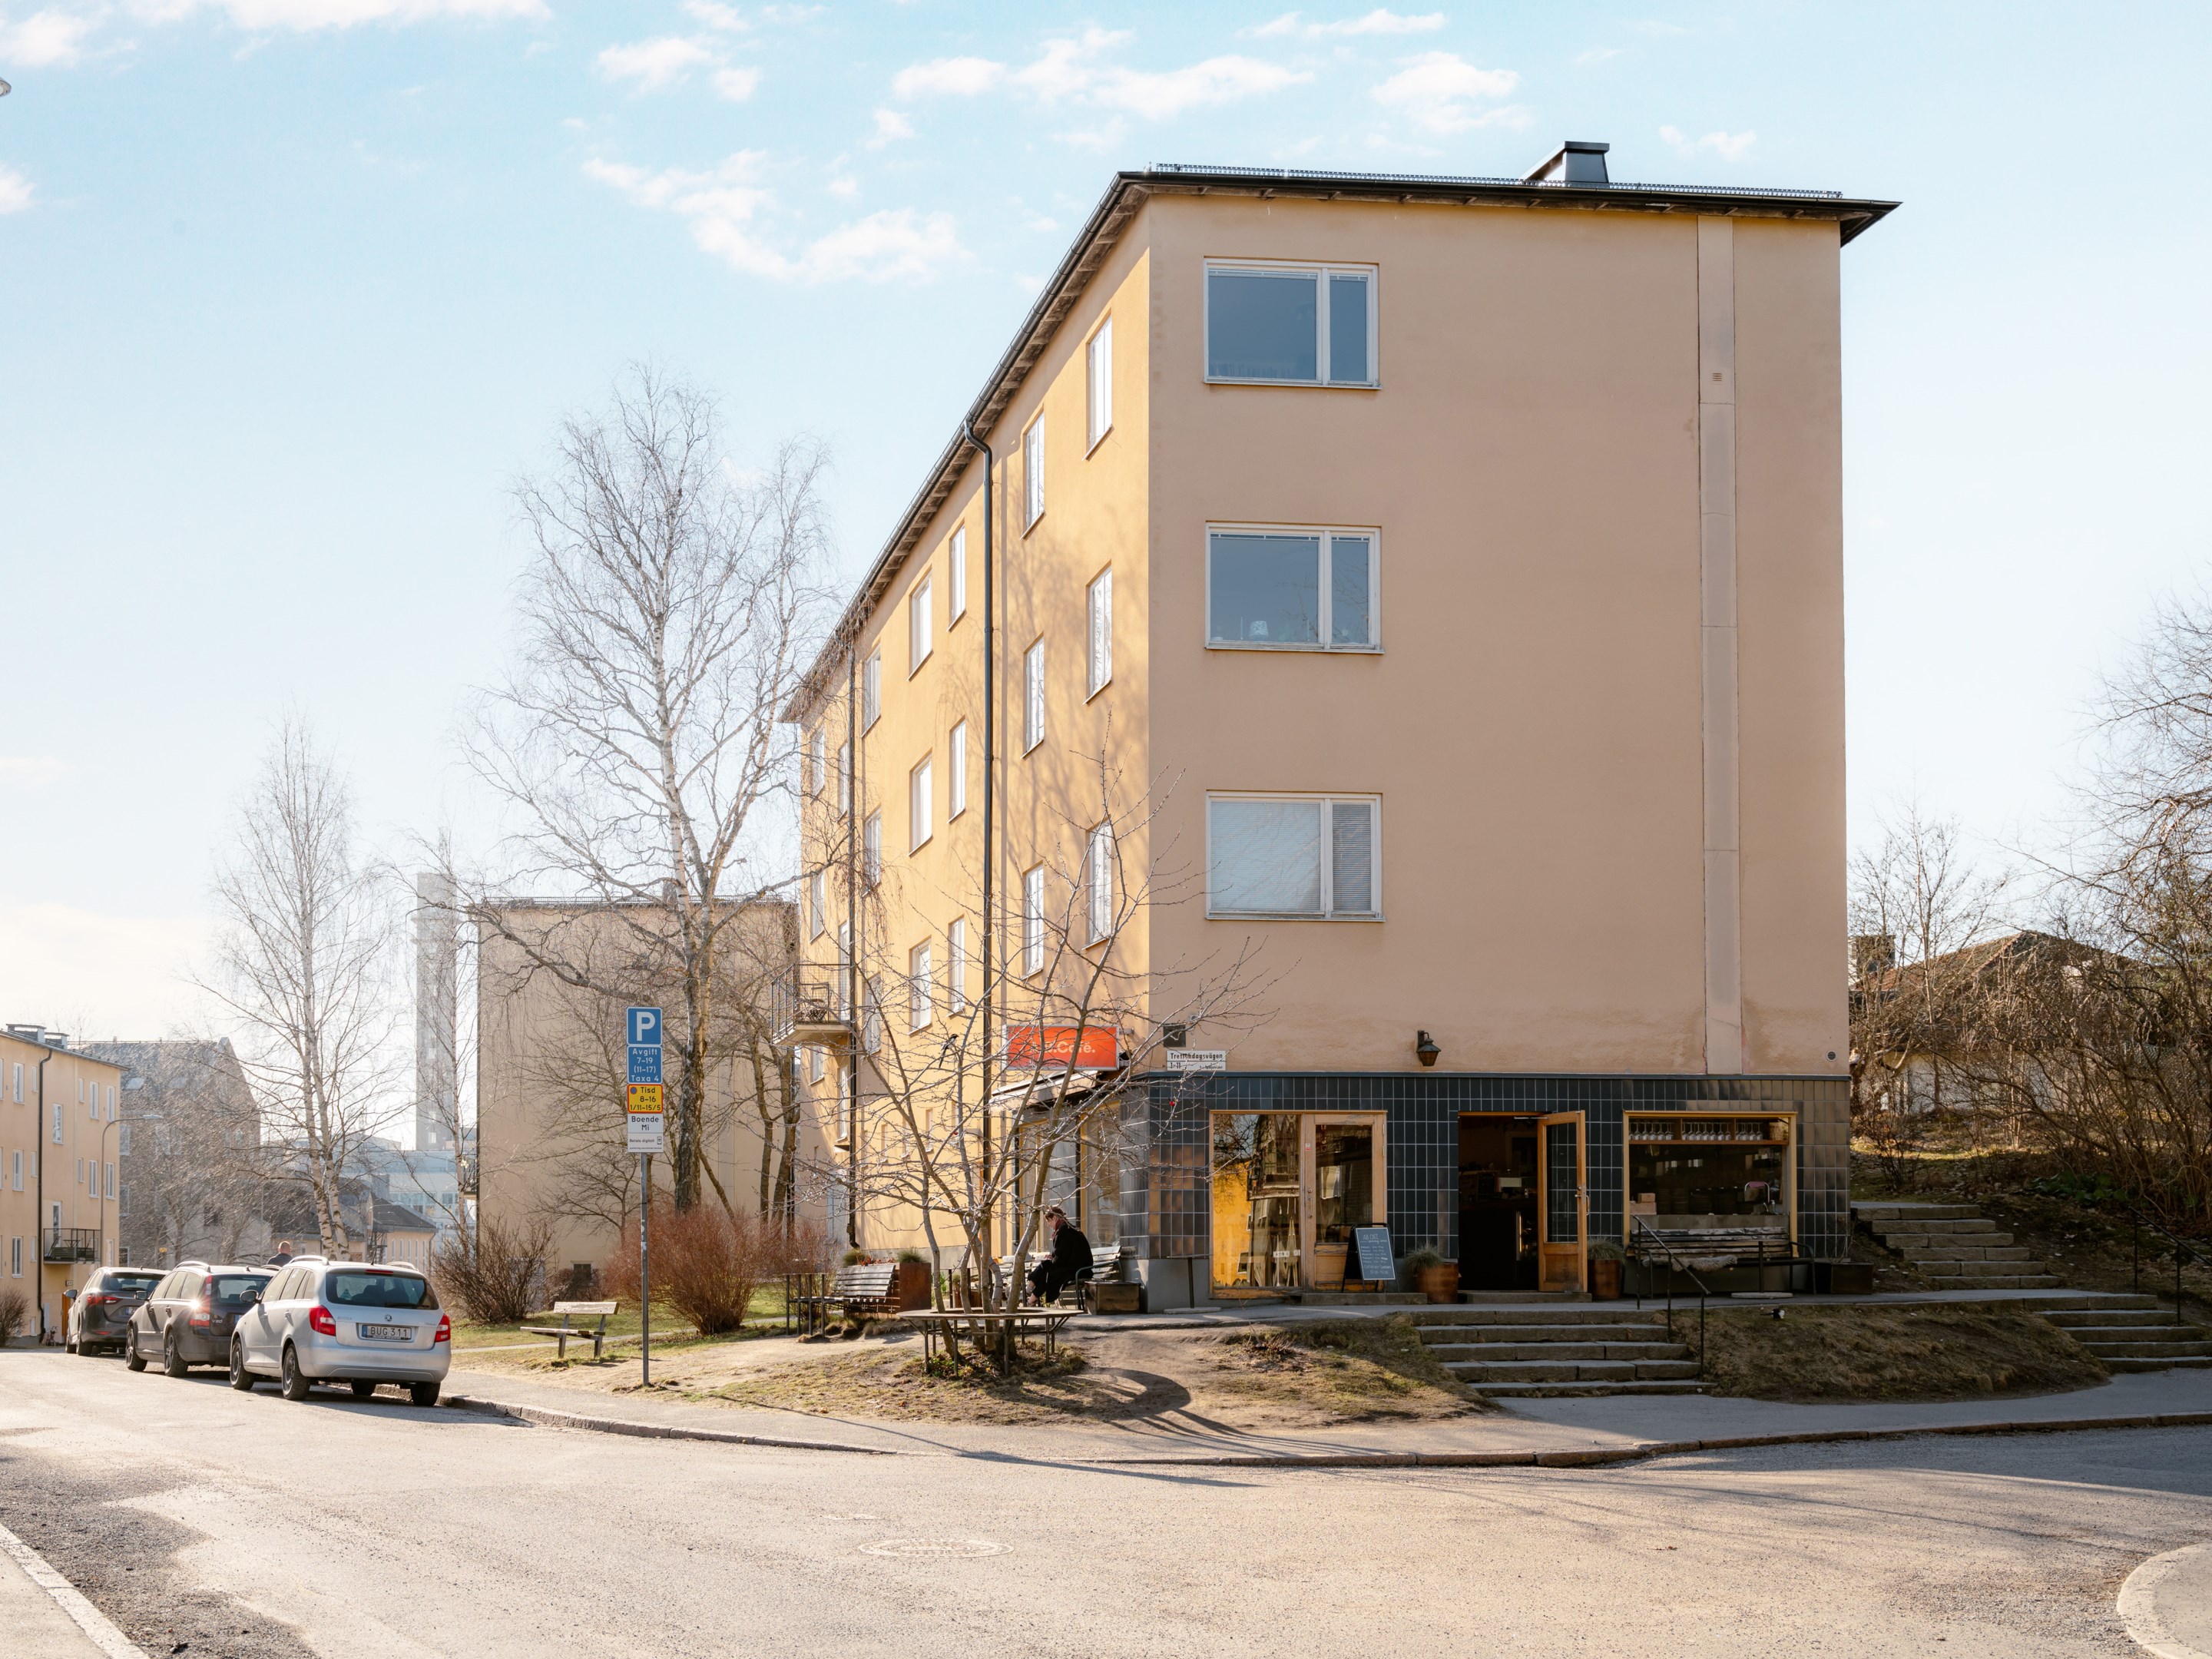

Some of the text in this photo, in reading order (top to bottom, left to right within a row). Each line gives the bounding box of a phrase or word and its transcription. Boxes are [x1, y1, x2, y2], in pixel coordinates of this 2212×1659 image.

[636, 1011, 656, 1041] P
[632, 1048, 657, 1057] Avgift
[634, 1065, 657, 1074] (11-17)
[370, 1326, 407, 1337] BUG 311
